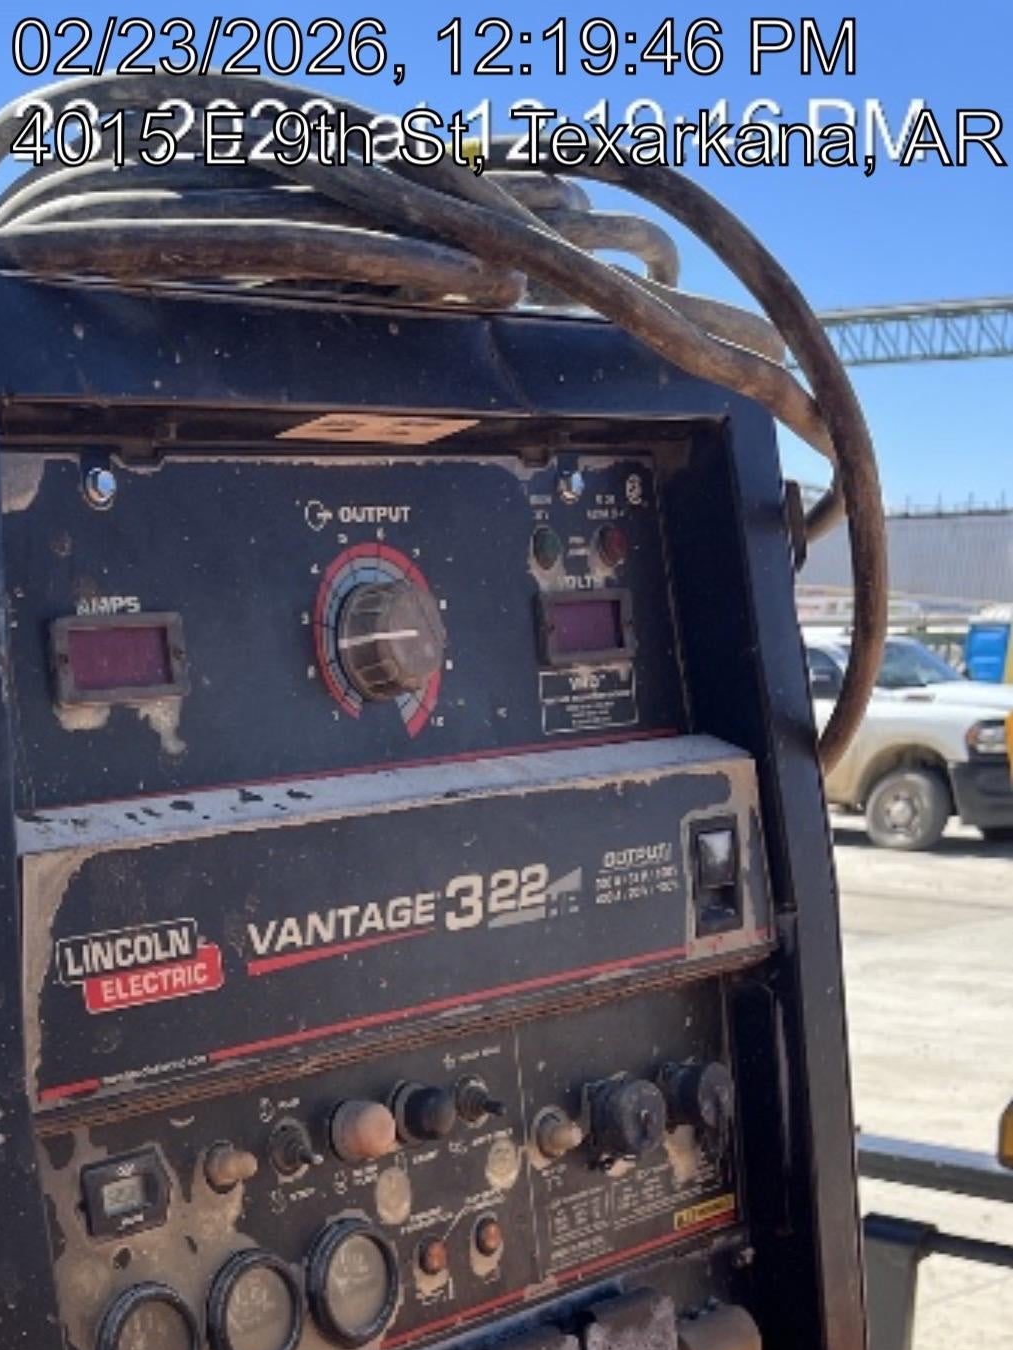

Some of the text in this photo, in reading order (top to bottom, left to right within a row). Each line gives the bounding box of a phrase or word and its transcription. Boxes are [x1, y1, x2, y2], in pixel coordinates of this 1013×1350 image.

[339, 506, 411, 523] OUTPUT
[247, 891, 436, 955] VANTAGE
[445, 863, 549, 931] 322
[64, 926, 192, 976] LINCOLN
[99, 962, 209, 1004] ELECTRIC
